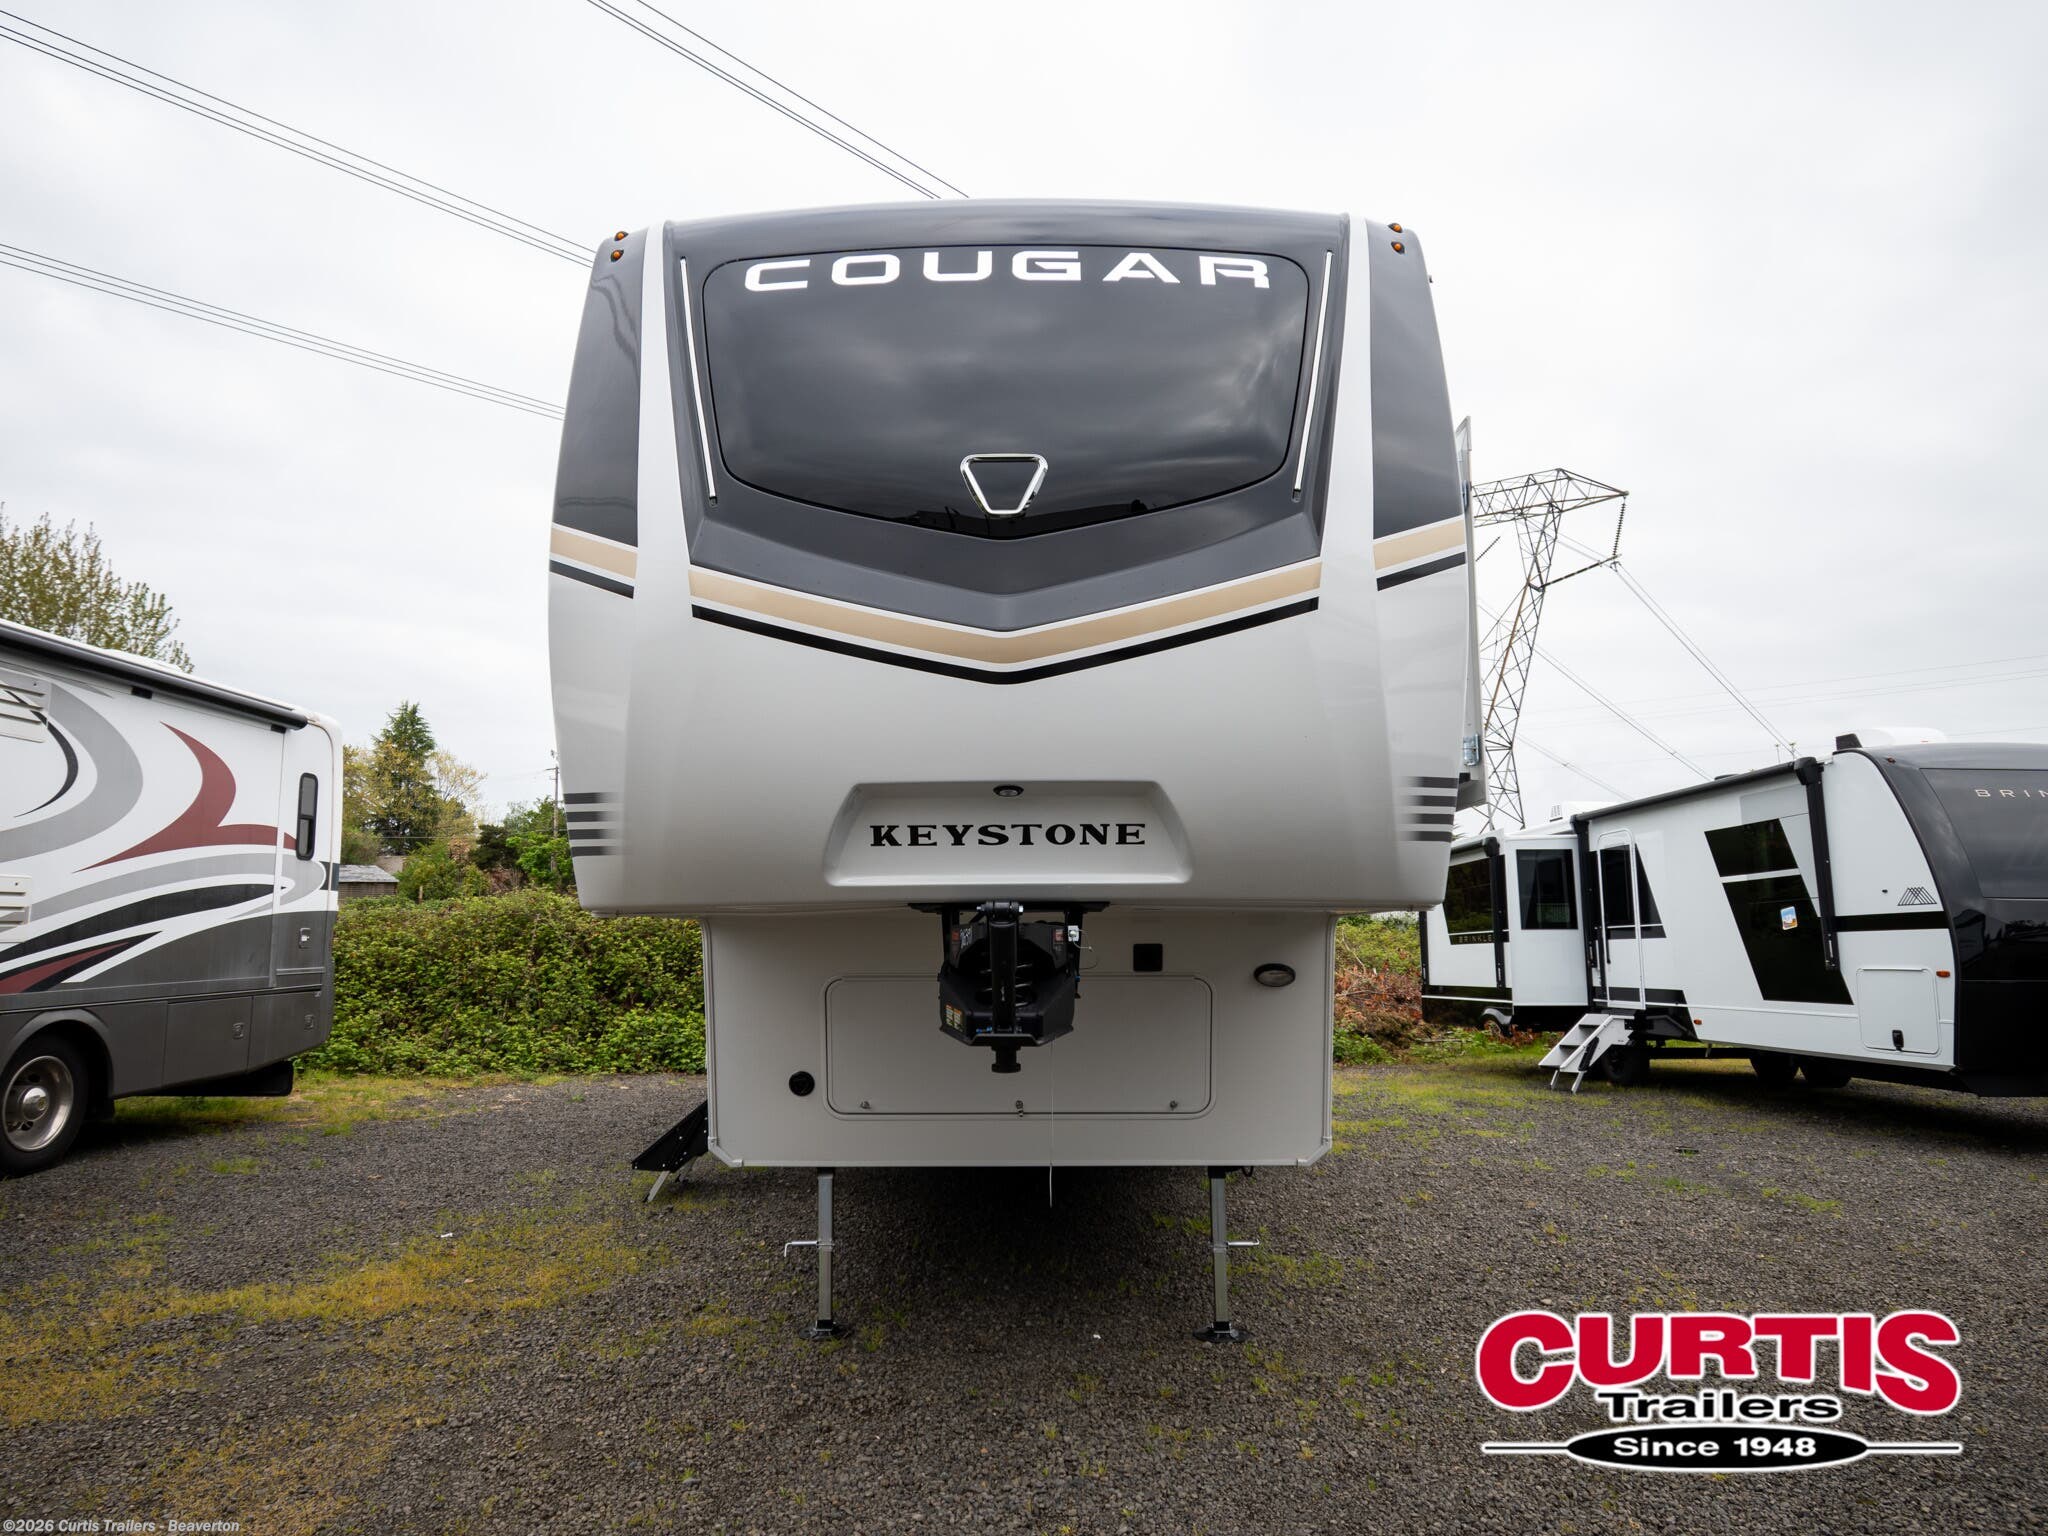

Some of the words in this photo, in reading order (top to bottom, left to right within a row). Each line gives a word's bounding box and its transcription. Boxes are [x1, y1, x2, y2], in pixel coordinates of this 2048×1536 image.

[744, 250, 1270, 292] COUGAR
[869, 823, 1146, 847] KEYSTONE
[1458, 934, 1493, 944] BRINKLE
